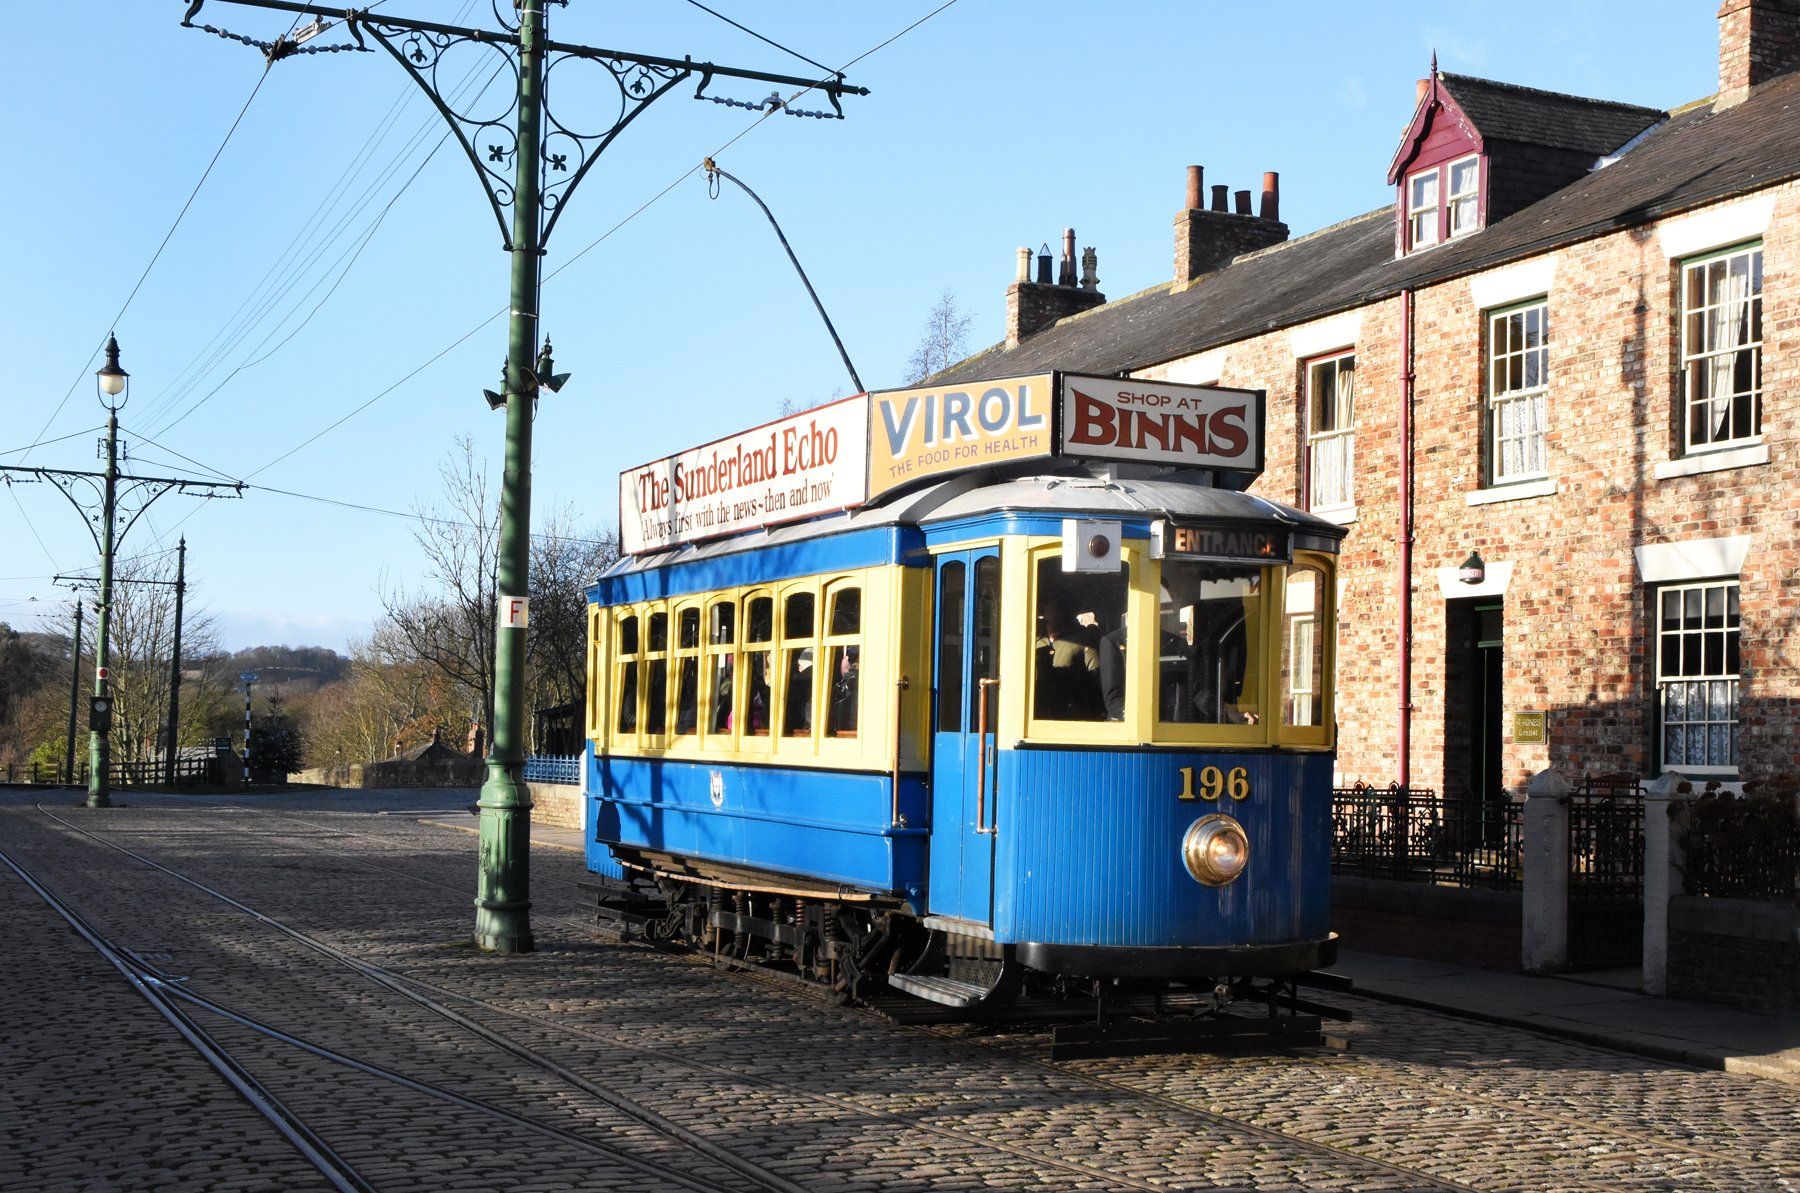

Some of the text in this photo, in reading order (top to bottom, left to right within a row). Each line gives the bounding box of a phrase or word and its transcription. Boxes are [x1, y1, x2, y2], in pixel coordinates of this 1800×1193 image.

[879, 384, 1047, 460] VIROL
[1068, 387, 1249, 457] BINNS
[1117, 392, 1202, 410] SHOP AT
[639, 420, 838, 513] The Sunderland Echo
[889, 435, 1038, 478] THE FOOD FOR HEALTH
[674, 512, 693, 537] first
[696, 505, 714, 528] with
[717, 503, 730, 524] the
[790, 479, 808, 507] and
[1175, 528, 1276, 557] ENTRANCE
[510, 600, 523, 623] F
[1178, 766, 1250, 801] 196
